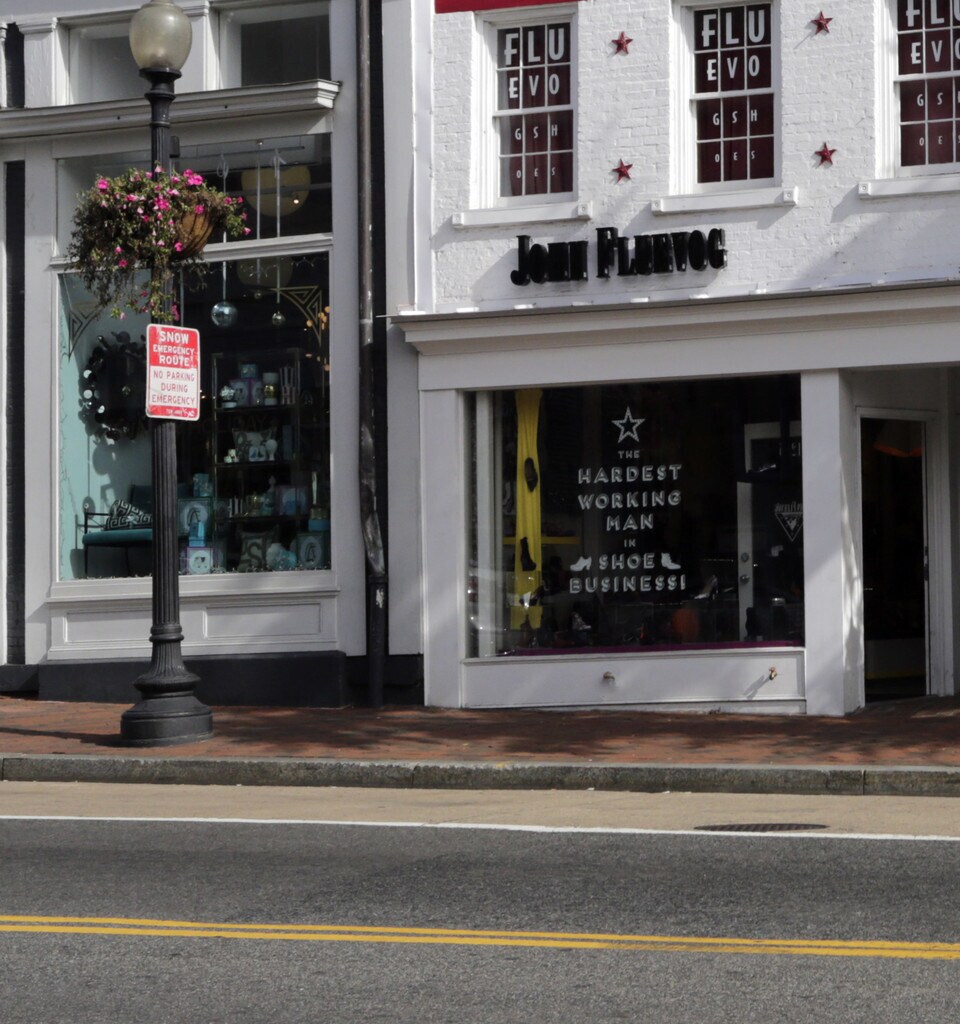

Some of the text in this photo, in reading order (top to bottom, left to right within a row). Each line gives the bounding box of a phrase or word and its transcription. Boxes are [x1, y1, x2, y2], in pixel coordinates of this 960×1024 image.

[702, 10, 765, 47] FLU
[504, 28, 565, 65] FLU
[706, 54, 760, 81] EVO
[508, 73, 560, 99] EVO
[159, 331, 190, 345] SNOW
[153, 344, 195, 356] EMERGENCY
[159, 355, 190, 367] ROUTE
[153, 370, 195, 382] NO PARKING
[160, 382, 188, 393] DURING
[152, 394, 195, 406] EMERGENCY
[618, 450, 640, 459] THE
[578, 464, 682, 485] HARDEST
[578, 490, 682, 510] WORKING
[606, 513, 654, 531] MAN
[624, 539, 636, 548] IN
[599, 552, 655, 570] SHOE
[569, 574, 687, 594] BUSINESS!
